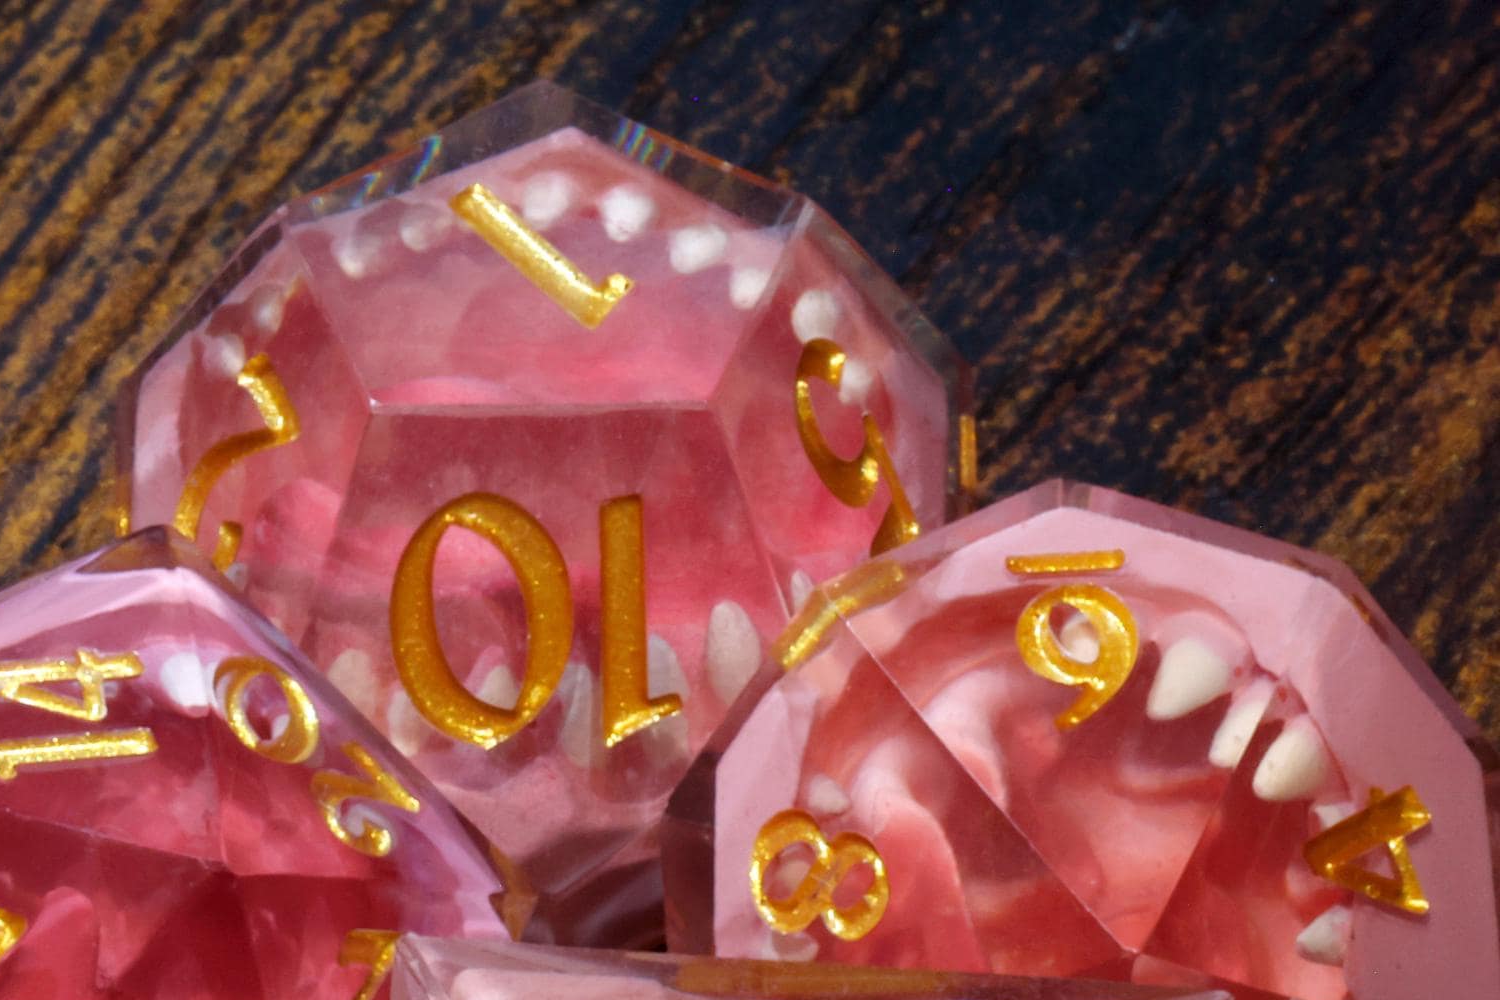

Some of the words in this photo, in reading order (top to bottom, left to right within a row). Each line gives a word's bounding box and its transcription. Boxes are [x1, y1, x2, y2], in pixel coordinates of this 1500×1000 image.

[449, 182, 637, 331] 1
[389, 491, 685, 752] 10
[213, 655, 422, 860] 20
[750, 808, 892, 943] 8
[1303, 784, 1434, 916] 4
